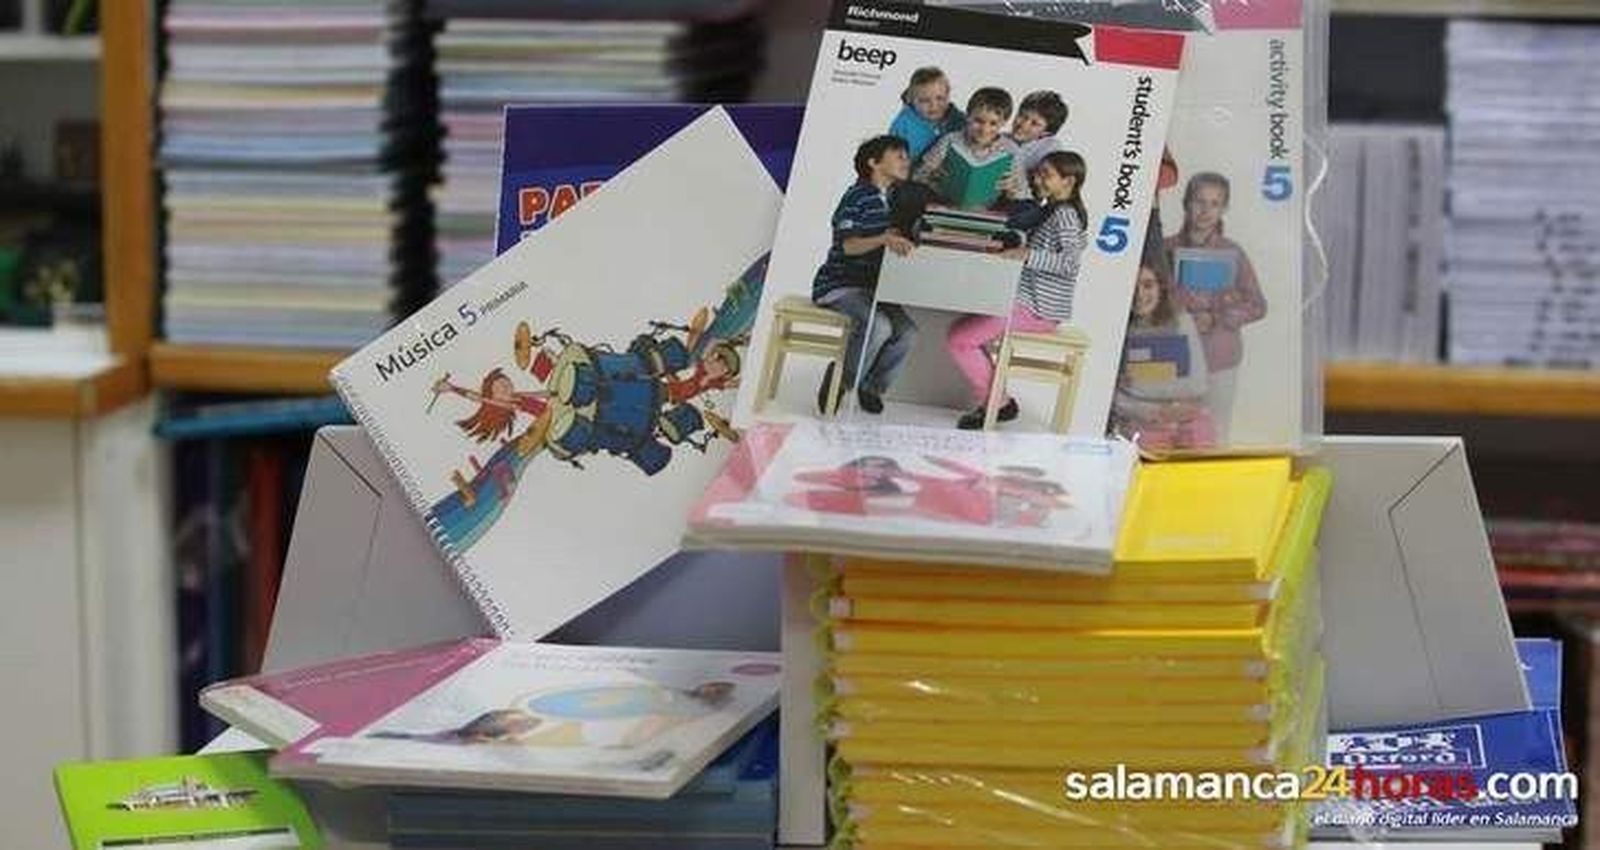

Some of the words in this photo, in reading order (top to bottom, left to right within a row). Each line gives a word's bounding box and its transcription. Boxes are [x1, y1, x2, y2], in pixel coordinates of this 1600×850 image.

[847, 6, 919, 23] Richmond
[837, 39, 897, 70] beep
[1266, 39, 1290, 110] activity
[1123, 76, 1152, 159] student's
[1270, 113, 1290, 160] book
[1113, 164, 1140, 210] book
[1261, 165, 1293, 201] 5
[1096, 215, 1130, 253] 5
[375, 322, 459, 382] Música
[457, 304, 478, 327] 5
[479, 281, 529, 316] PRIMARIA
[1343, 750, 1457, 766] Oxford
